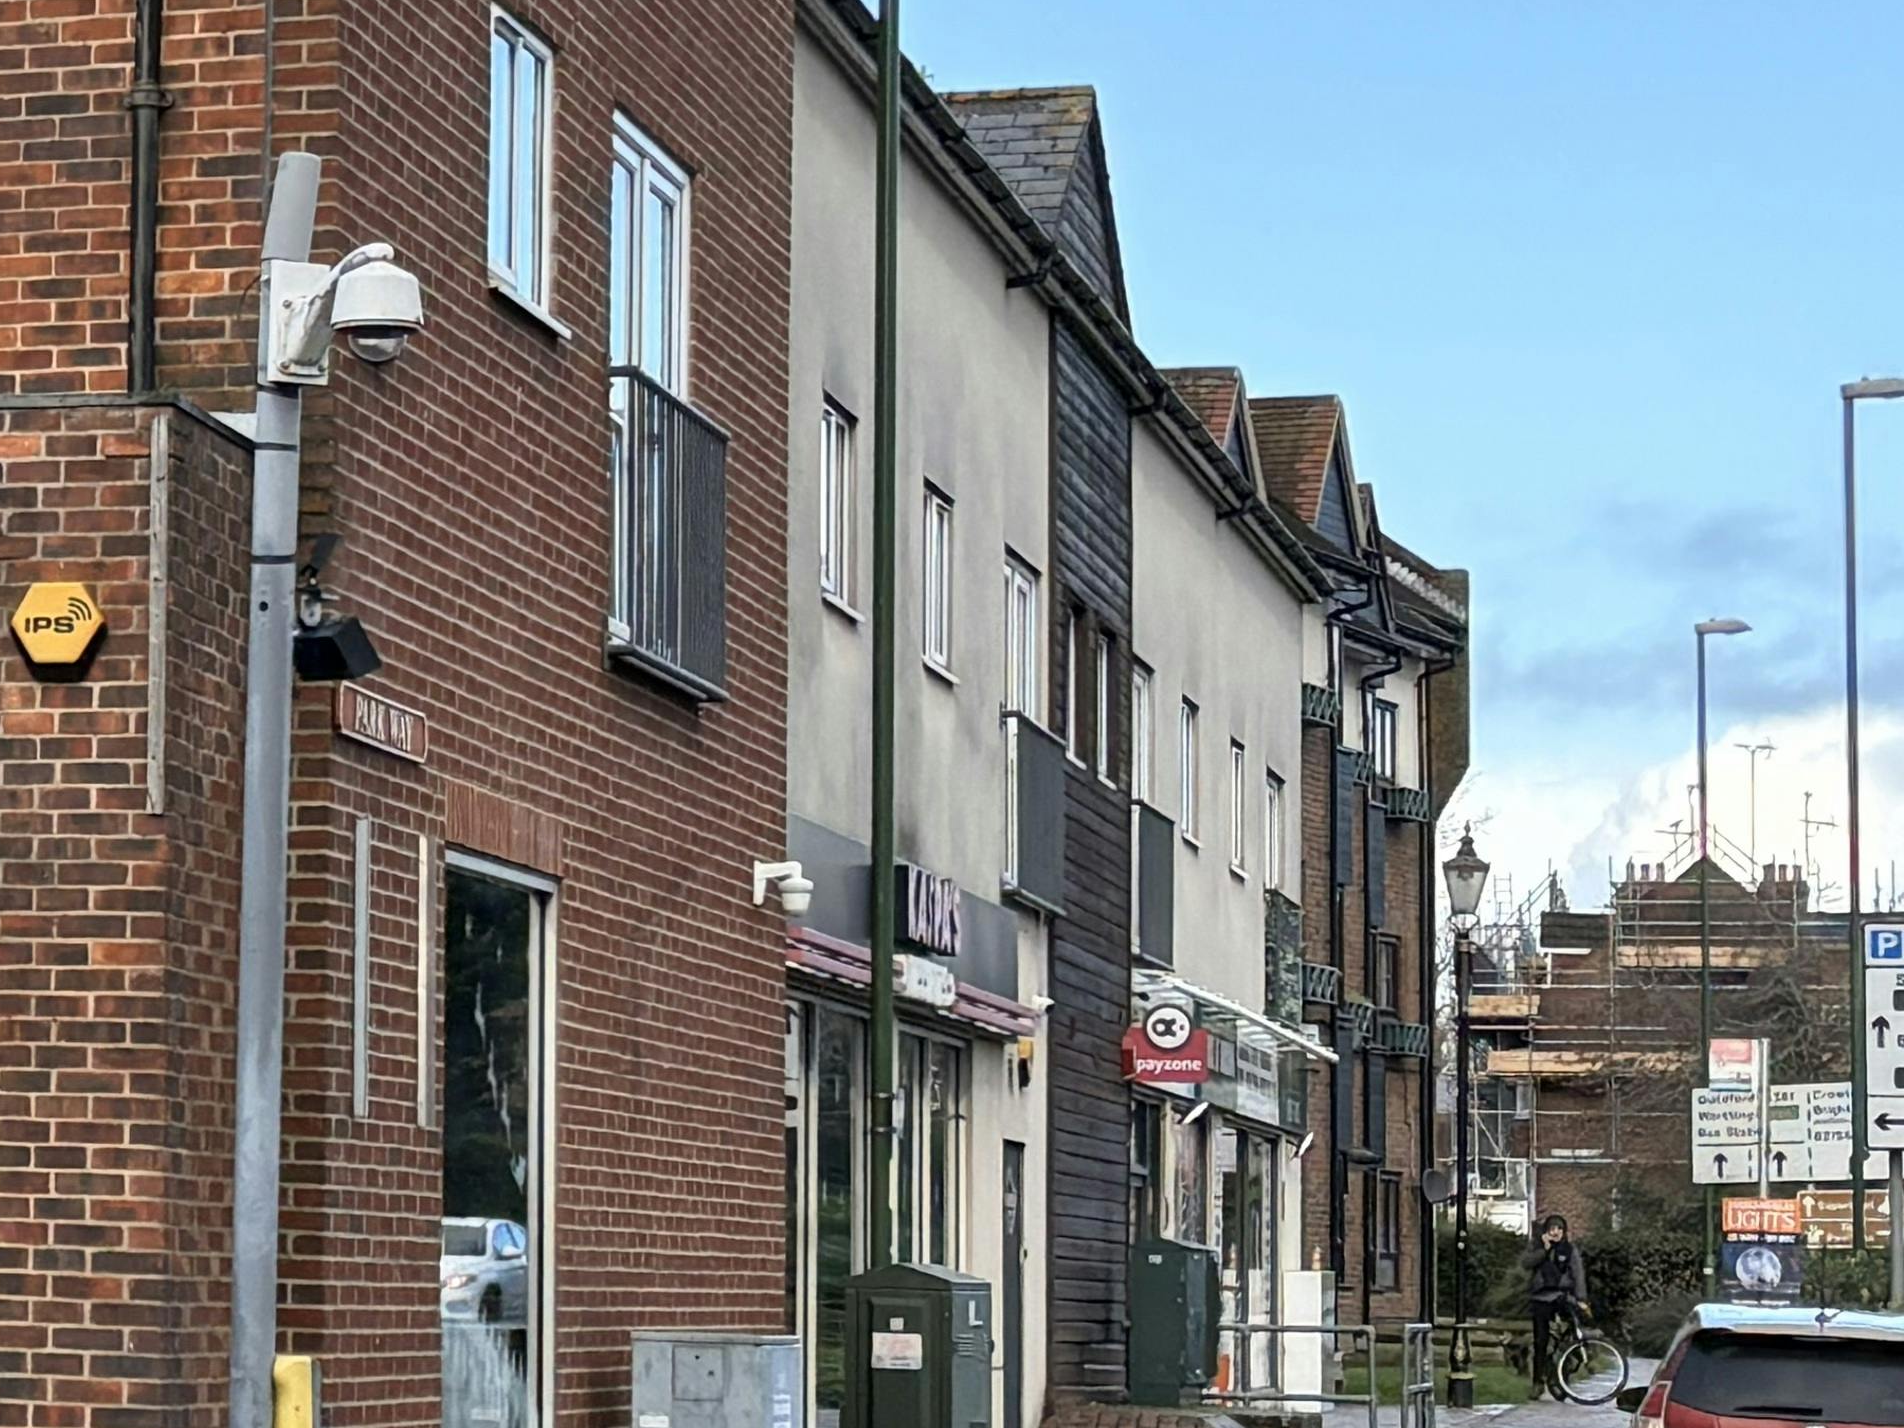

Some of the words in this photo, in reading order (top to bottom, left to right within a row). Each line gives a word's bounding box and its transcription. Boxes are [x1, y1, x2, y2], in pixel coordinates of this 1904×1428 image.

[25, 616, 74, 633] IPS
[1878, 933, 1899, 958] P
[1136, 1059, 1202, 1074] payzone
